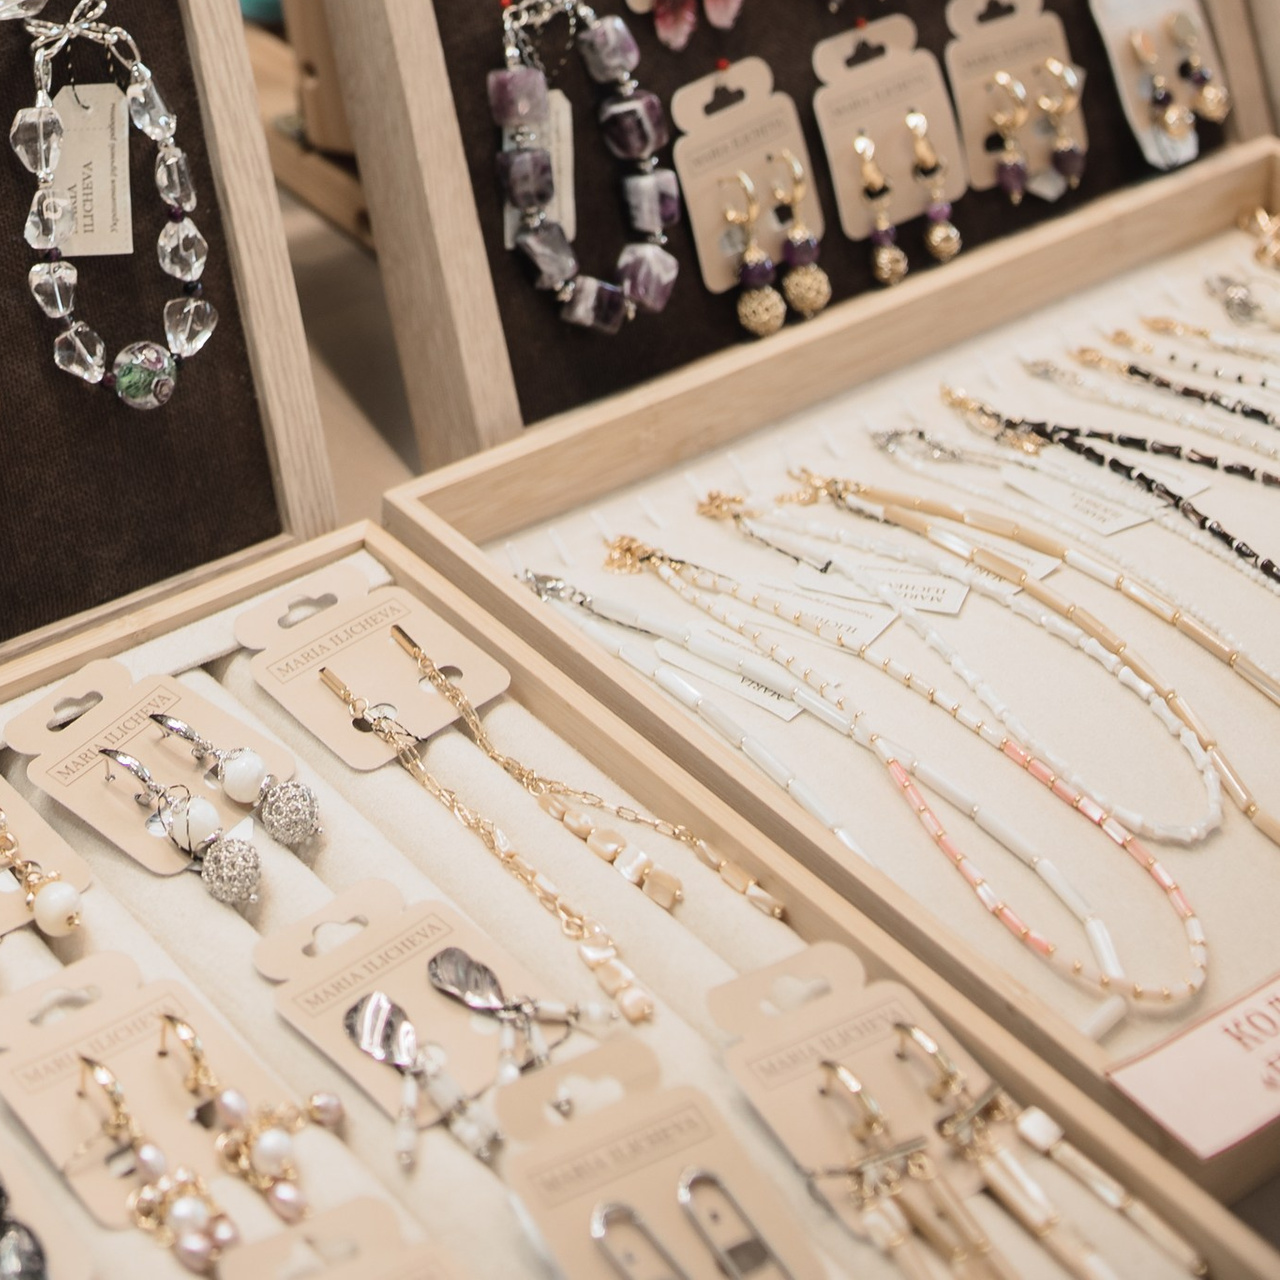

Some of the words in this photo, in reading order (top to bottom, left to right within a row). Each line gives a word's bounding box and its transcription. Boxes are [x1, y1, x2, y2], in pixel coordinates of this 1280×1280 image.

[82, 160, 95, 234] ILICHEVA
[276, 643, 331, 678] MARIA
[329, 604, 402, 647] ILICHEVA
[56, 741, 106, 780] MARIA
[104, 693, 172, 745] ILICHEVA
[304, 970, 366, 1011] MARIA
[363, 922, 443, 975] ILICHEVA
